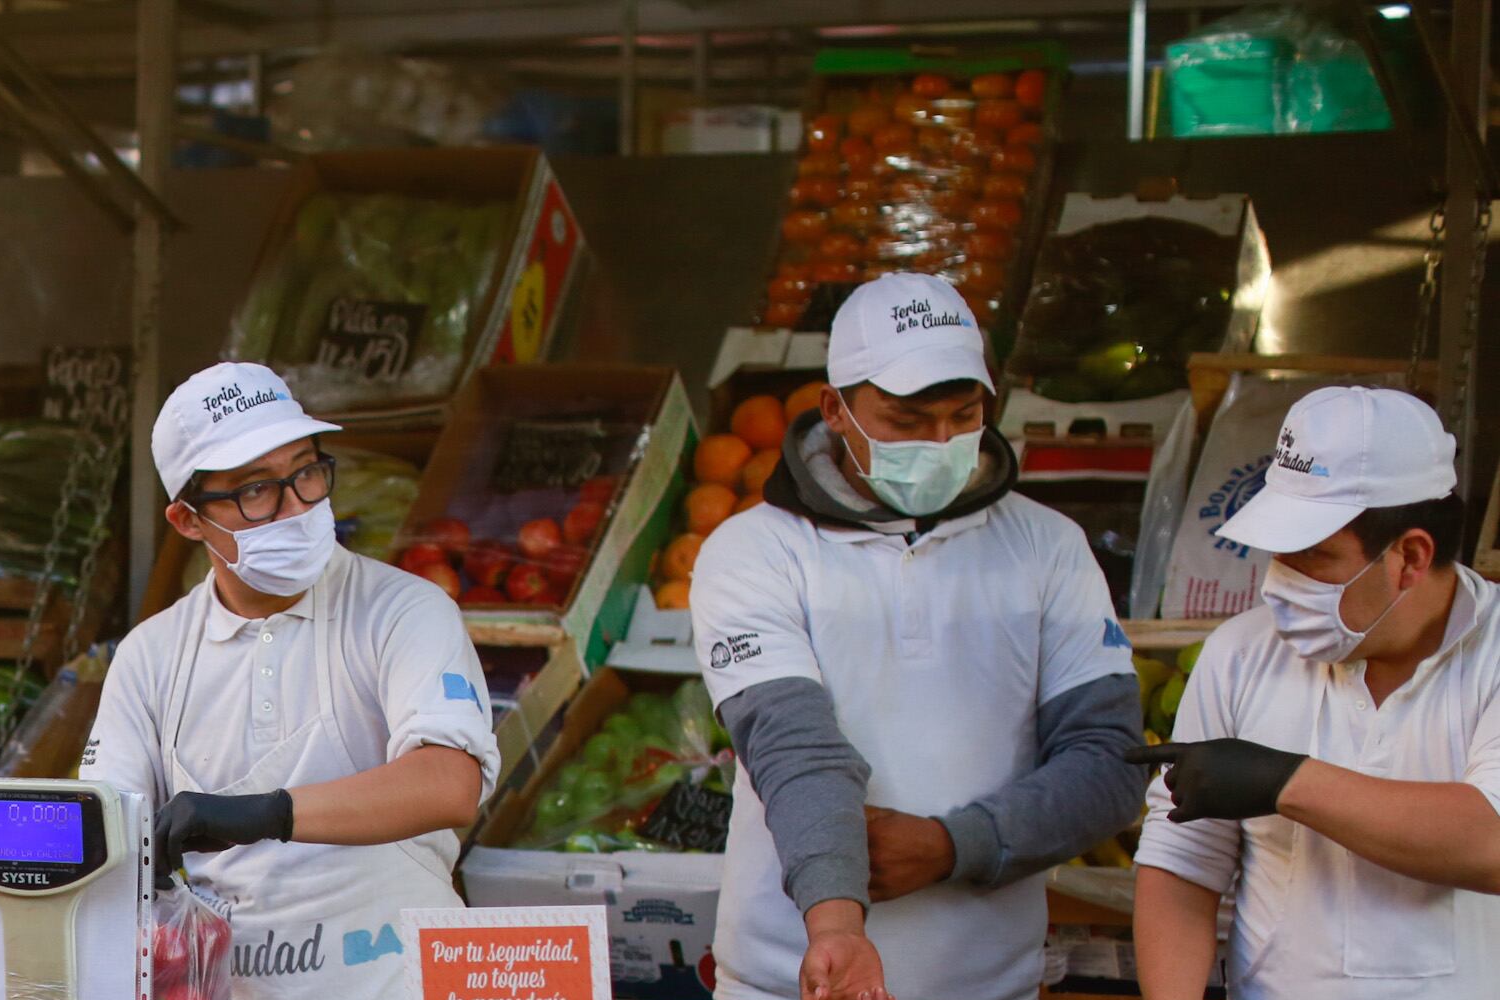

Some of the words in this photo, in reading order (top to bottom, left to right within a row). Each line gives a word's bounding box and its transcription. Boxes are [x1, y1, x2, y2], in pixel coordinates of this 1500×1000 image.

[890, 298, 931, 321] Ferias
[922, 312, 962, 329] Ciudad
[202, 383, 242, 411] Ferias
[235, 387, 277, 413] Ciudad
[8, 803, 68, 823] 0.000
[1, 872, 50, 885] SYSTEL
[431, 940, 463, 963] Por
[466, 941, 484, 963] tu
[486, 938, 579, 971] seguridad,
[466, 971, 488, 989] no
[491, 967, 546, 996] toques
